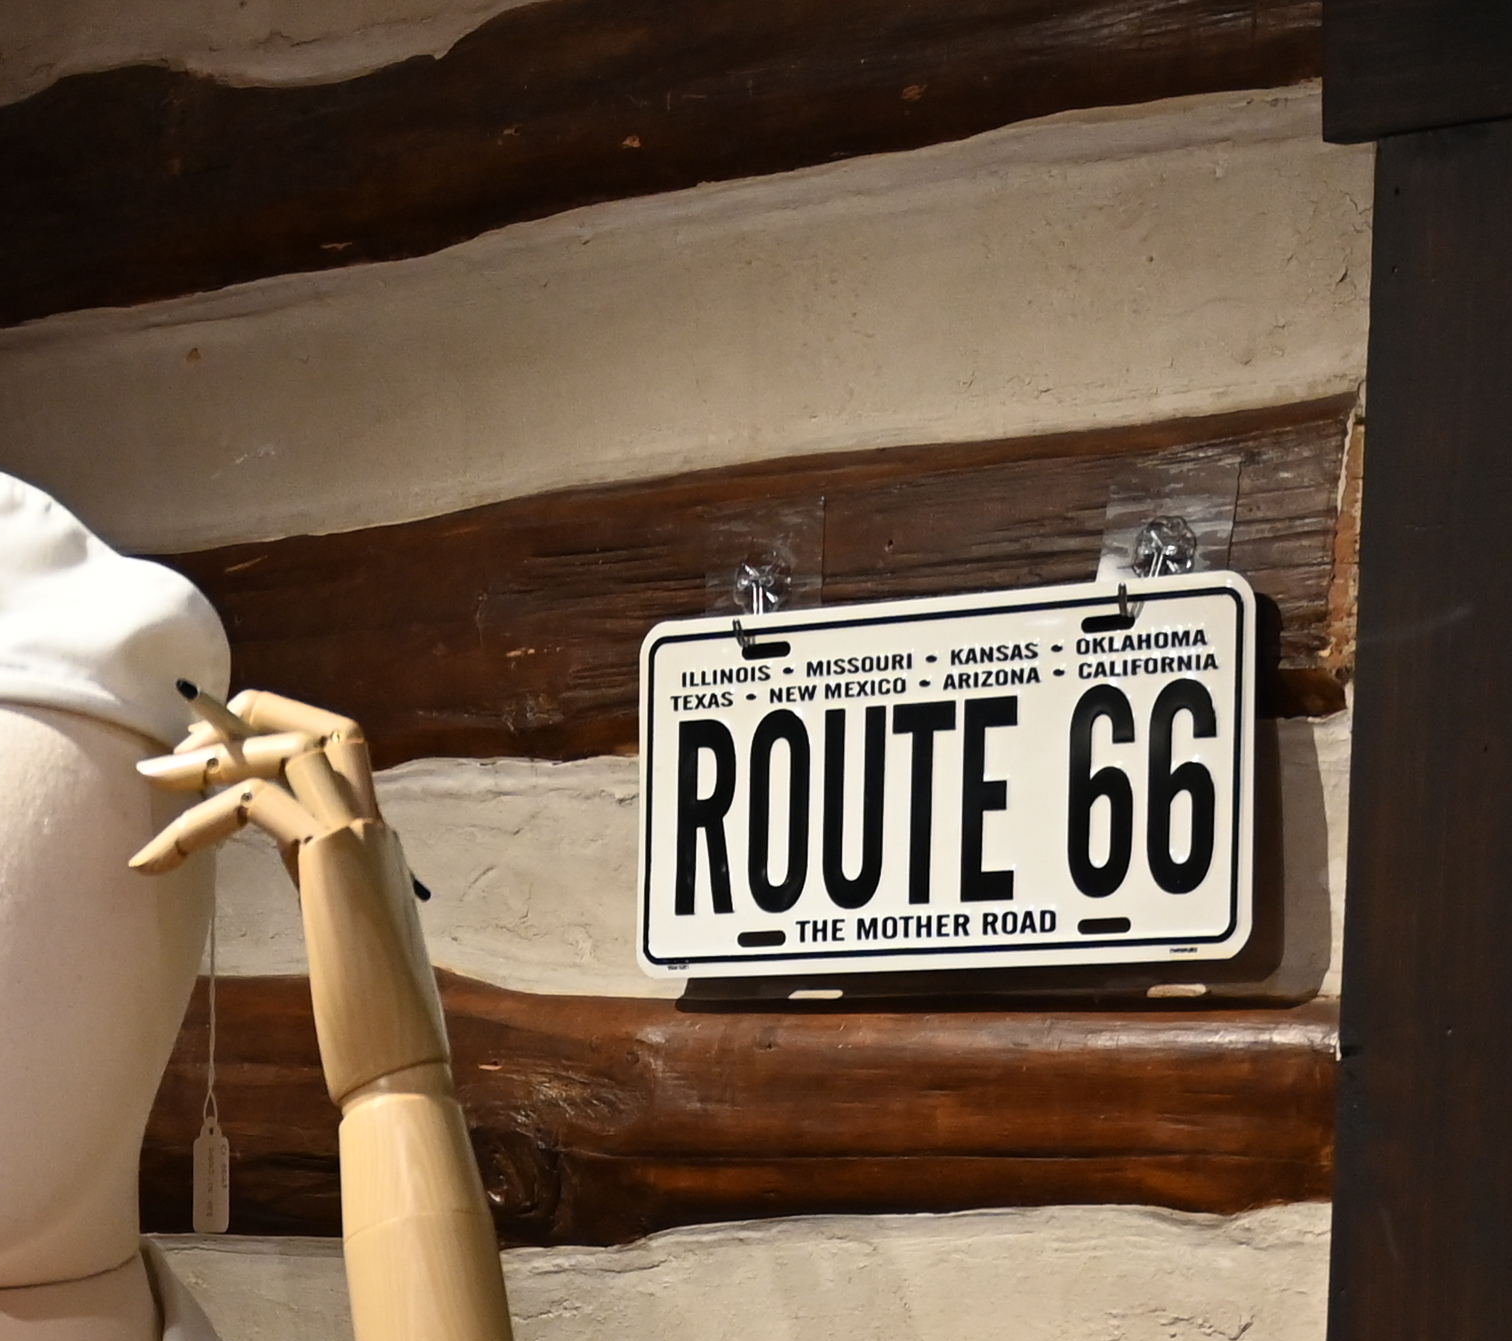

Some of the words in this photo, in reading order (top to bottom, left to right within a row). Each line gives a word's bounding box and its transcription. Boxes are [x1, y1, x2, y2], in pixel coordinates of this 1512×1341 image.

[670, 690, 735, 712] TEXAS
[769, 684, 818, 705] NEW
[824, 676, 908, 701] MEXICO
[942, 667, 1041, 691] ARIZONA
[1077, 652, 1219, 681] CALIFORNIA
[681, 664, 772, 688] ILLINOIS
[805, 652, 914, 679] MISSOURI
[949, 641, 1040, 665] KANSAS
[1075, 629, 1208, 655] OKLAHOMA
[674, 694, 1019, 916] ROUTE
[1067, 678, 1217, 898] 66
[795, 917, 849, 944] THE
[856, 912, 971, 941] MOTHER
[982, 909, 1057, 935] ROAD
